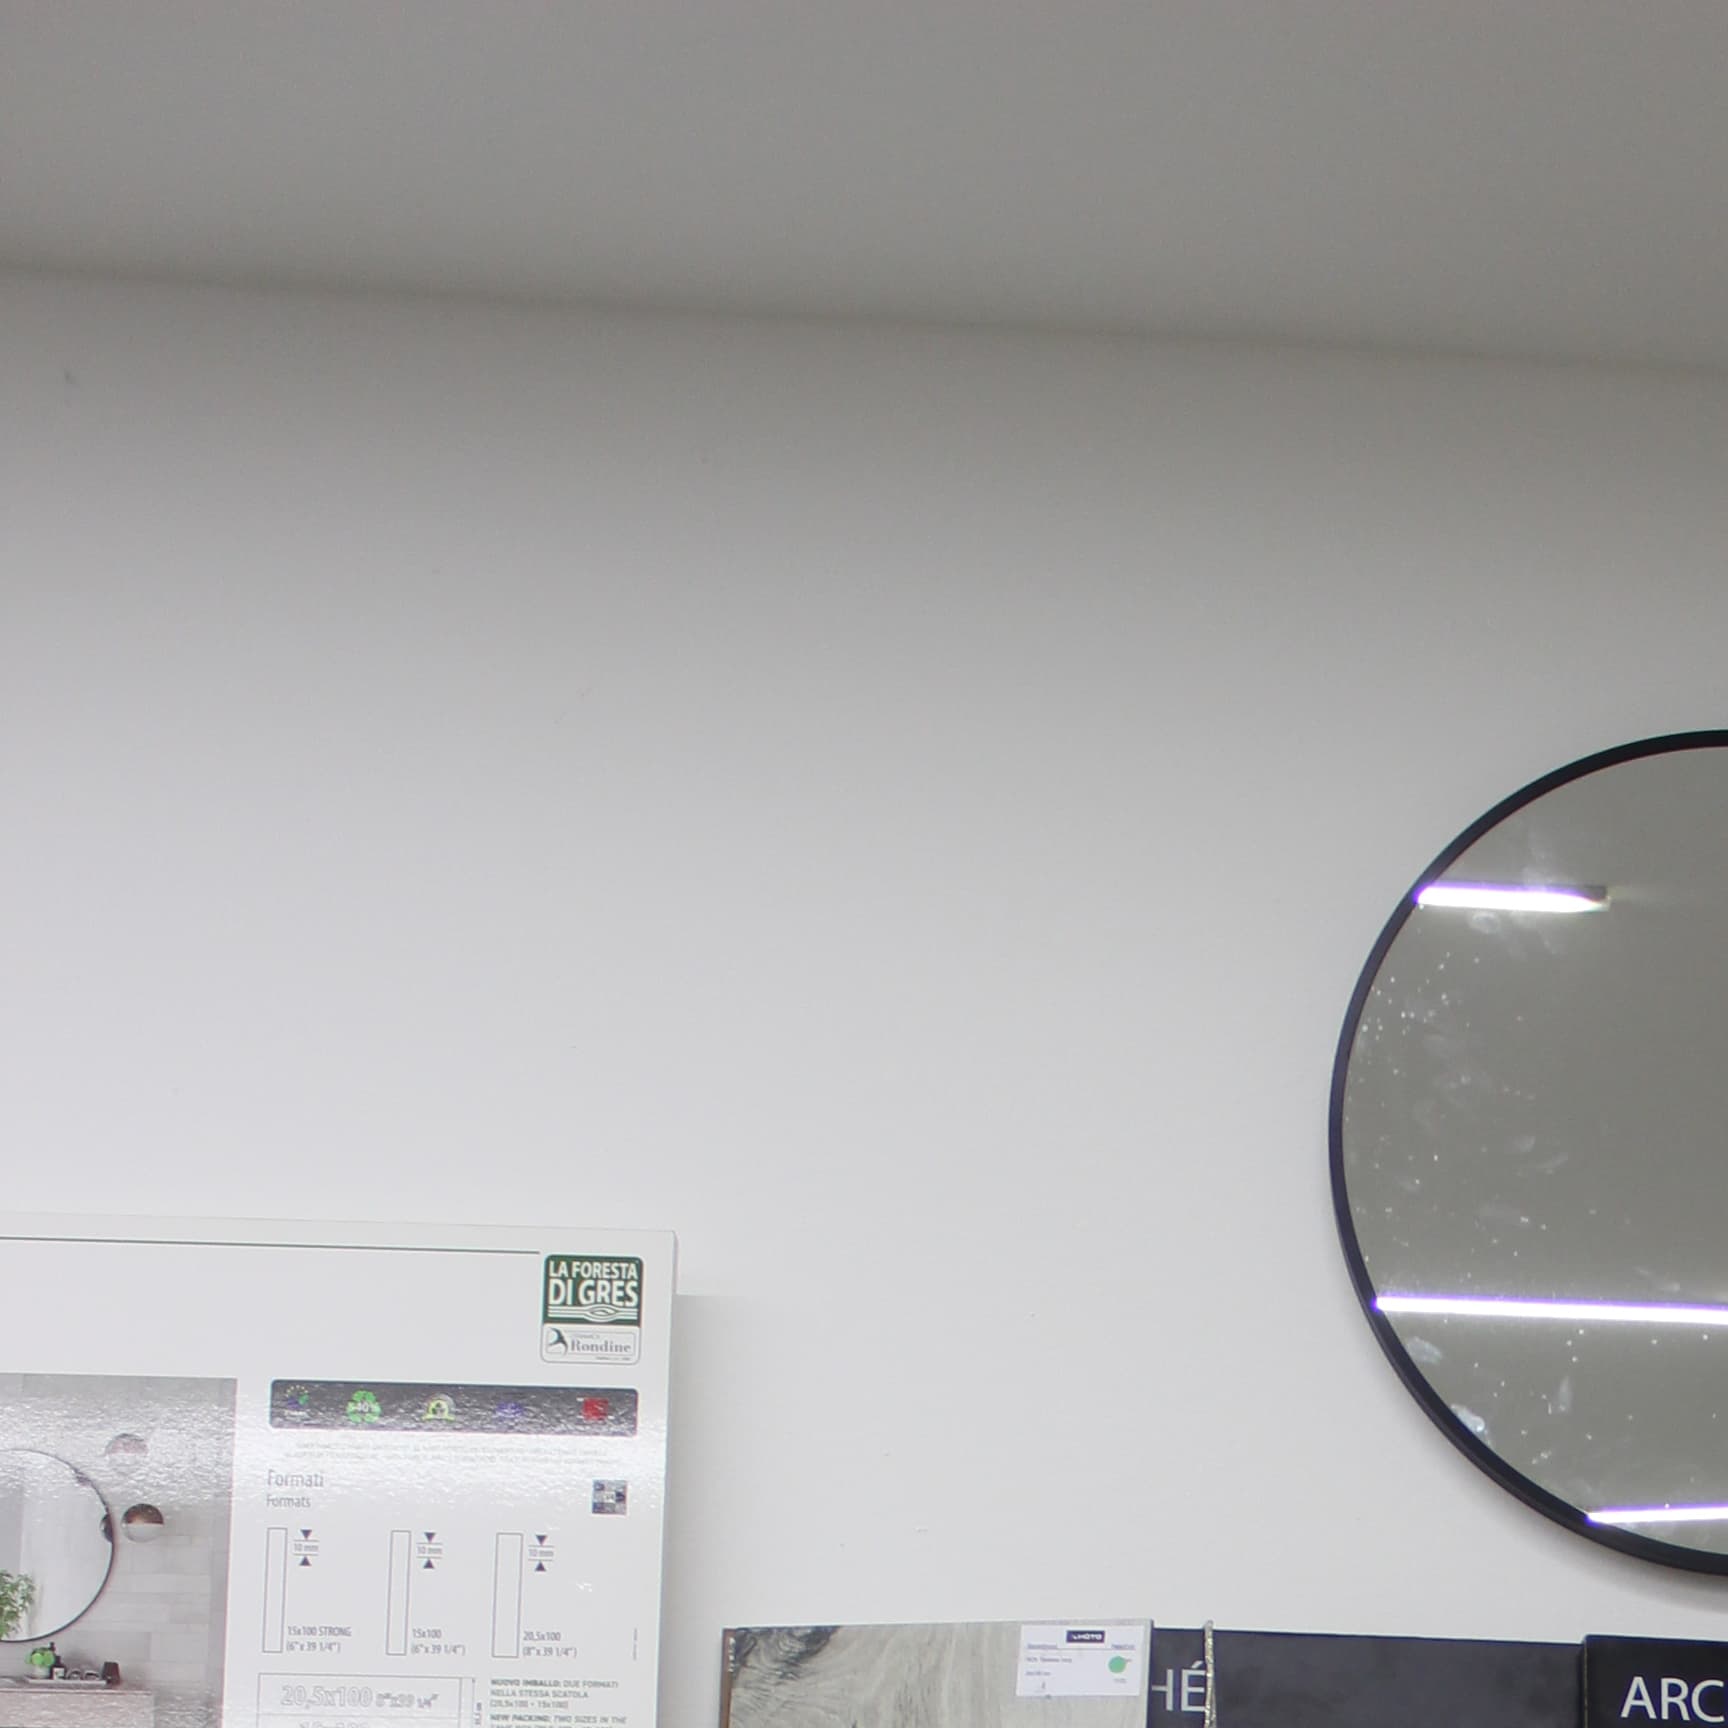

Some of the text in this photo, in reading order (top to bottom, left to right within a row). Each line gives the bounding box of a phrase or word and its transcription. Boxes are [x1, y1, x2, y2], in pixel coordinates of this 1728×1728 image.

[548, 1261, 638, 1279] LA FORESTA
[548, 1279, 638, 1306] DI GRES
[571, 1340, 632, 1353] Rondine
[266, 1495, 311, 1509] Formats
